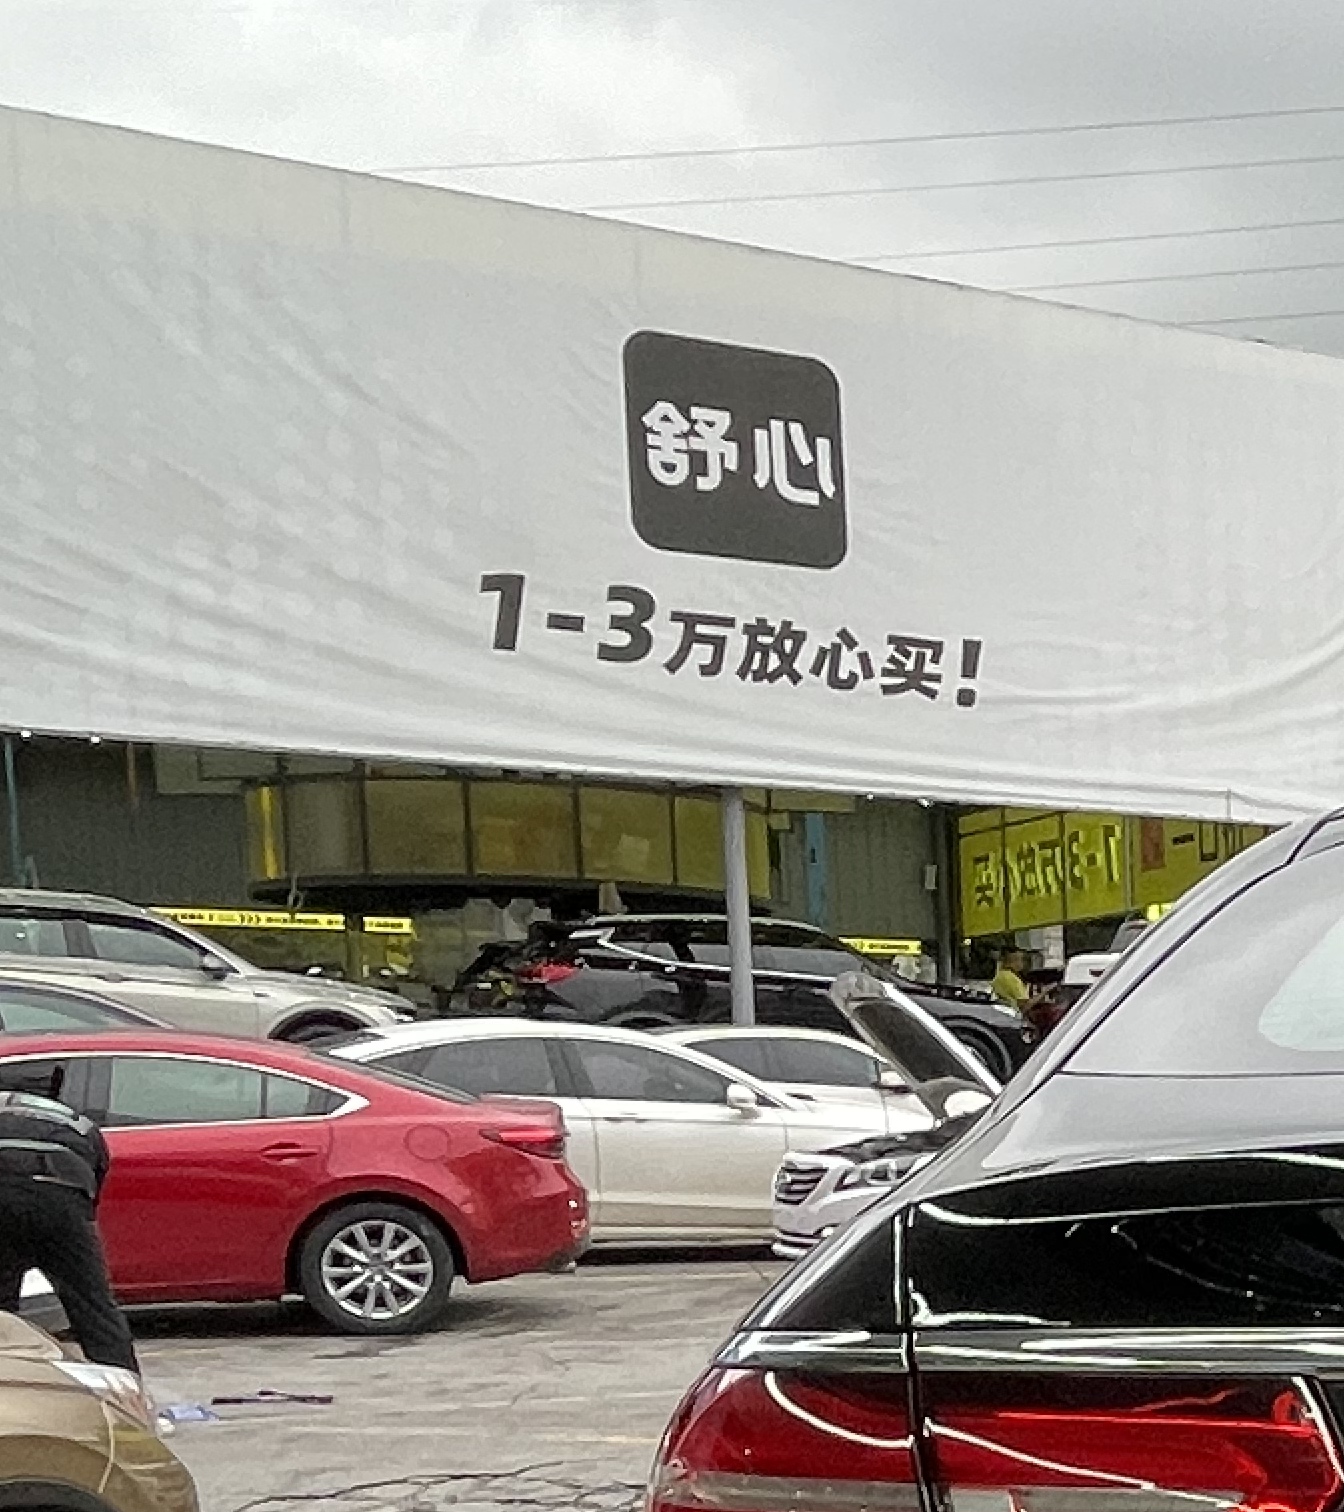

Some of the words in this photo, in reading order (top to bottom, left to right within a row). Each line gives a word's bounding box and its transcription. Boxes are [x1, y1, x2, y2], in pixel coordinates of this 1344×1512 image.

[641, 400, 836, 505] 舒心
[479, 574, 982, 708] 1-3万放心买!
